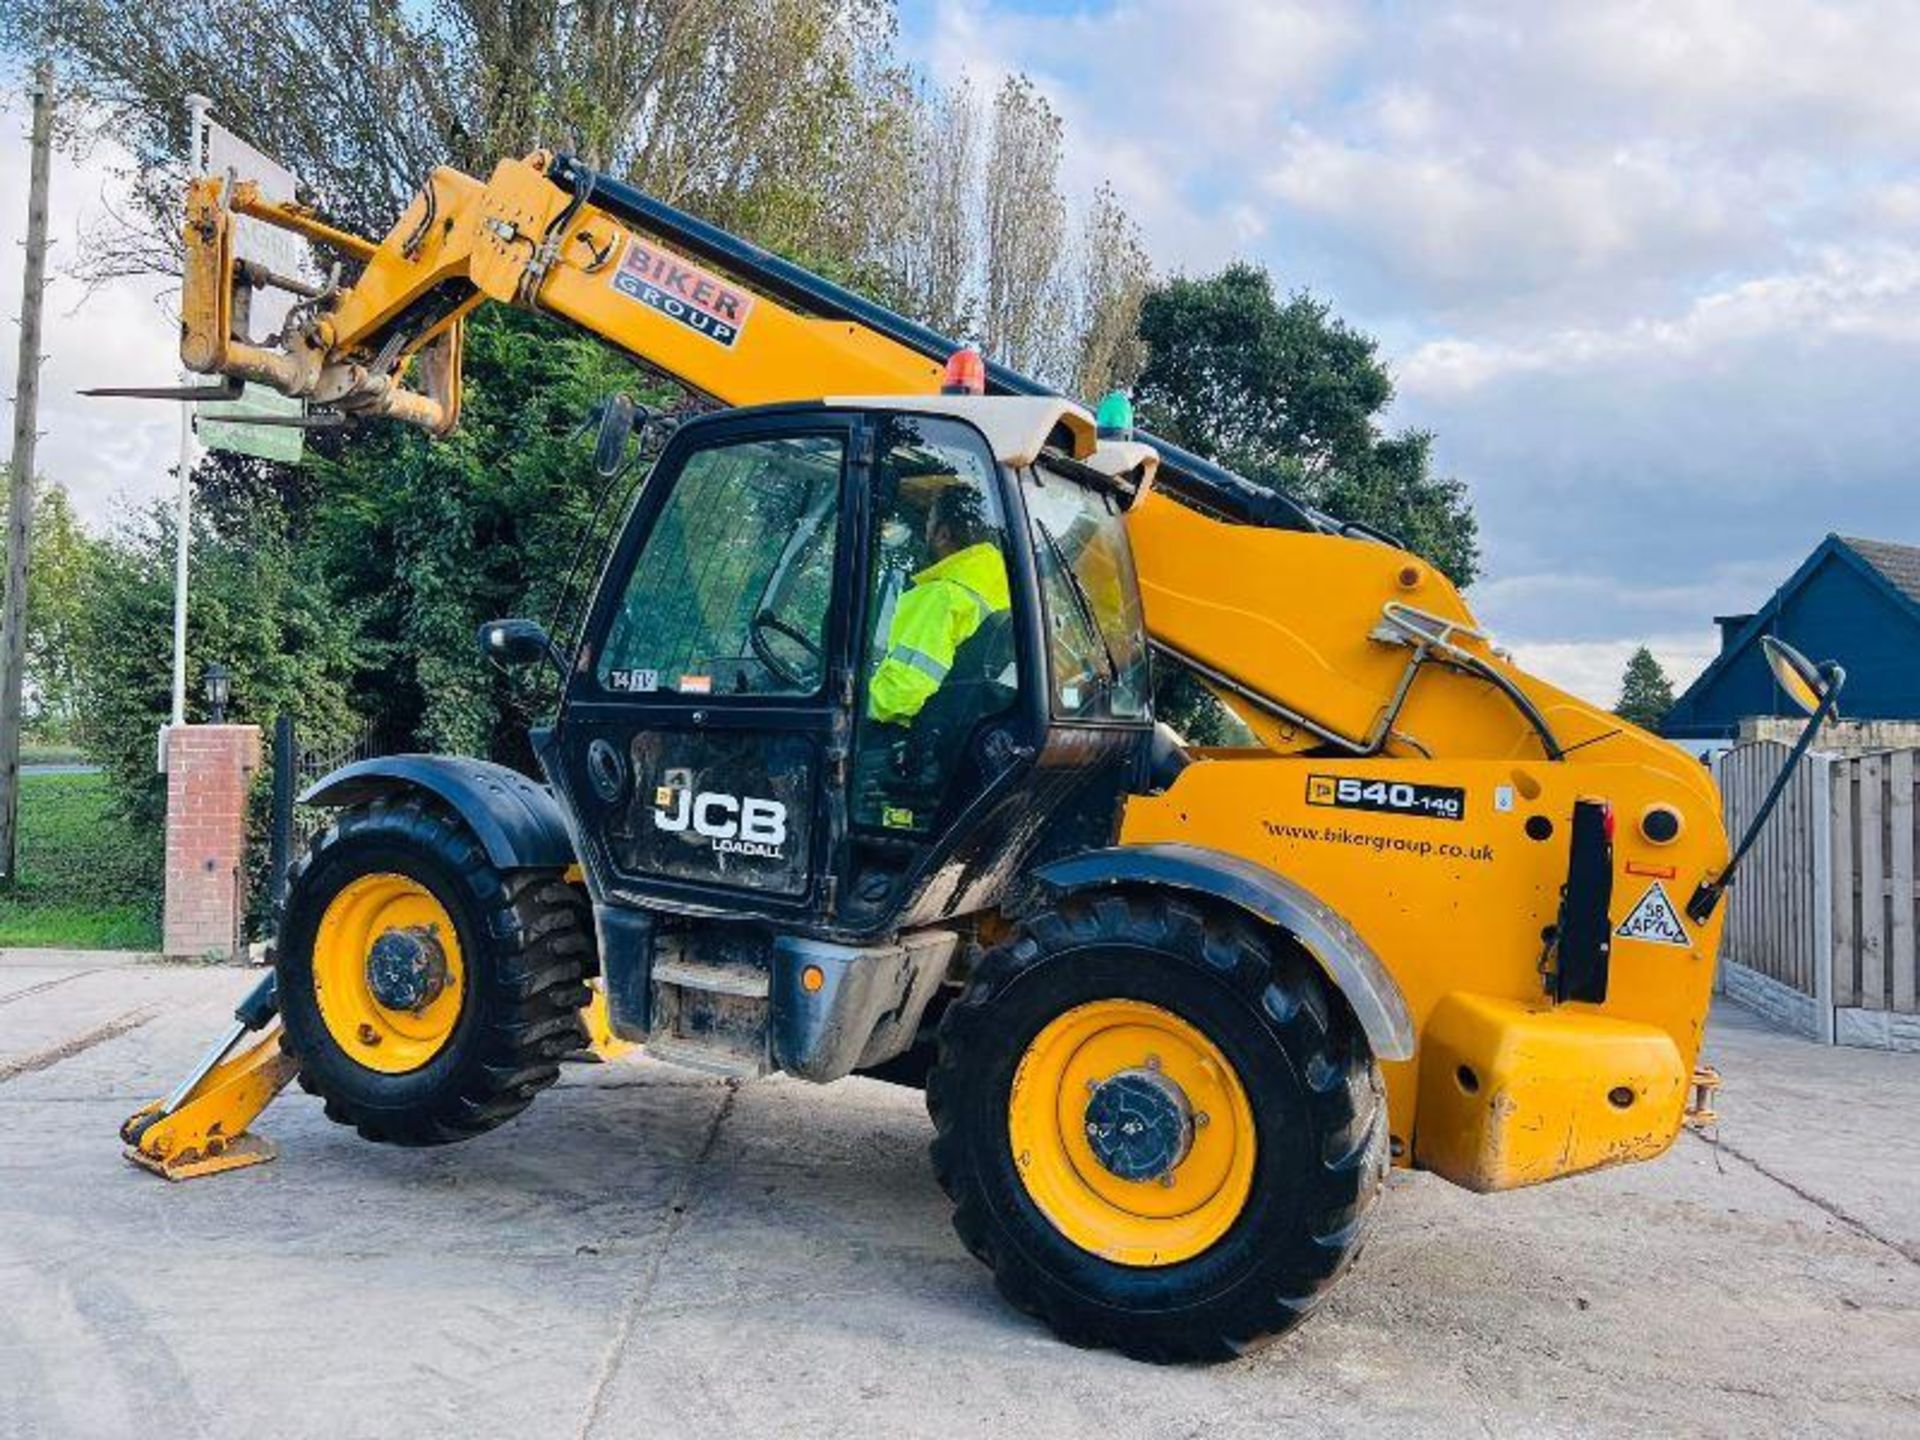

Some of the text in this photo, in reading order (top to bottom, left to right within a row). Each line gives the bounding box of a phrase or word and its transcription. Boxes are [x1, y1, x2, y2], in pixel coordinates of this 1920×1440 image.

[619, 275, 731, 338] GROUP
[628, 246, 740, 320] BIKER
[654, 788, 787, 846] JCB
[1336, 778, 1459, 812] 540-140
[711, 838, 784, 860] LOADALL
[1267, 823, 1494, 862] www.bikergroup.co.uk
